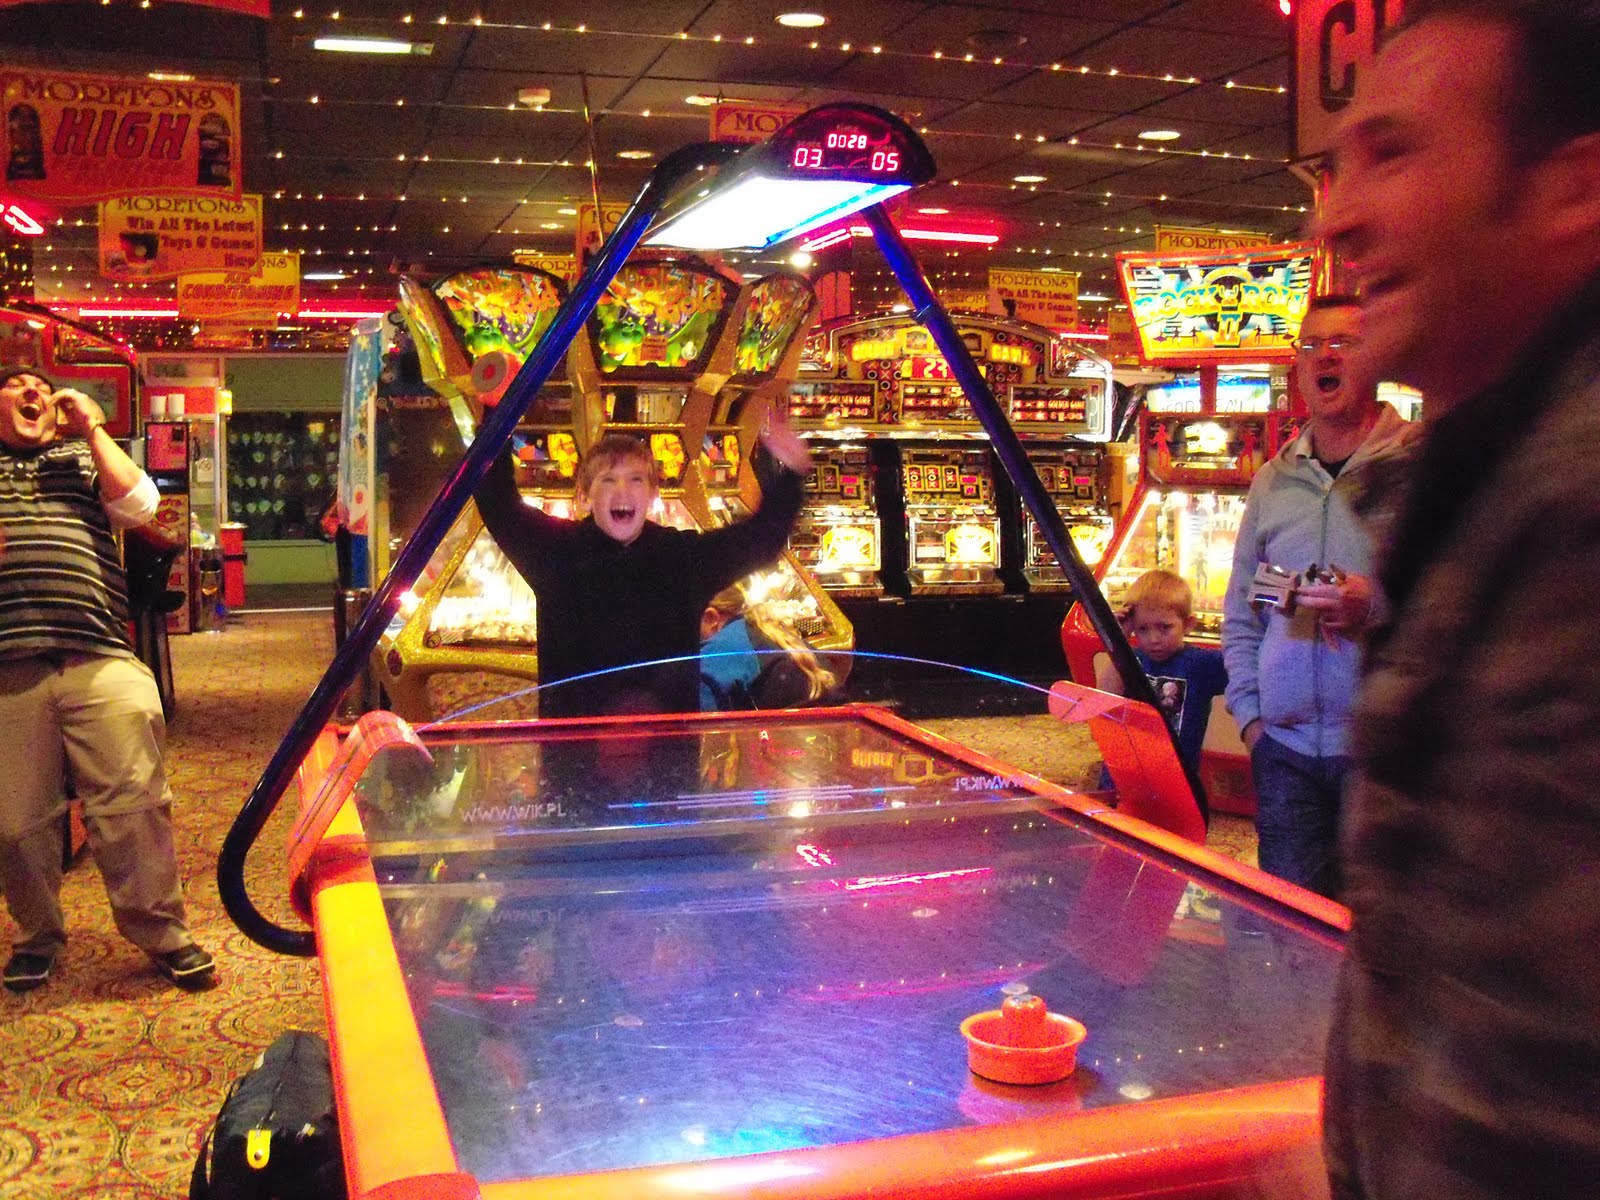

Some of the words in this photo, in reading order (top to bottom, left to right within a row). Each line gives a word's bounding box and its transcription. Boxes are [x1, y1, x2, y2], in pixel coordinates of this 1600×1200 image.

[53, 106, 191, 160] HIGH
[827, 133, 868, 149] 0028
[794, 147, 823, 168] 03
[871, 151, 899, 172] 05
[117, 197, 246, 214] MORETONS
[127, 216, 154, 230] Win
[158, 217, 180, 231] All
[184, 218, 210, 231] The
[161, 235, 192, 250] Toys
[1169, 235, 1262, 250] MORETONS
[991, 274, 1069, 288] MORETONS
[997, 288, 1014, 297] Win
[1016, 289, 1029, 298] All
[1031, 289, 1046, 299] The
[1018, 301, 1036, 312] Toys
[991, 344, 1033, 366] GAME
